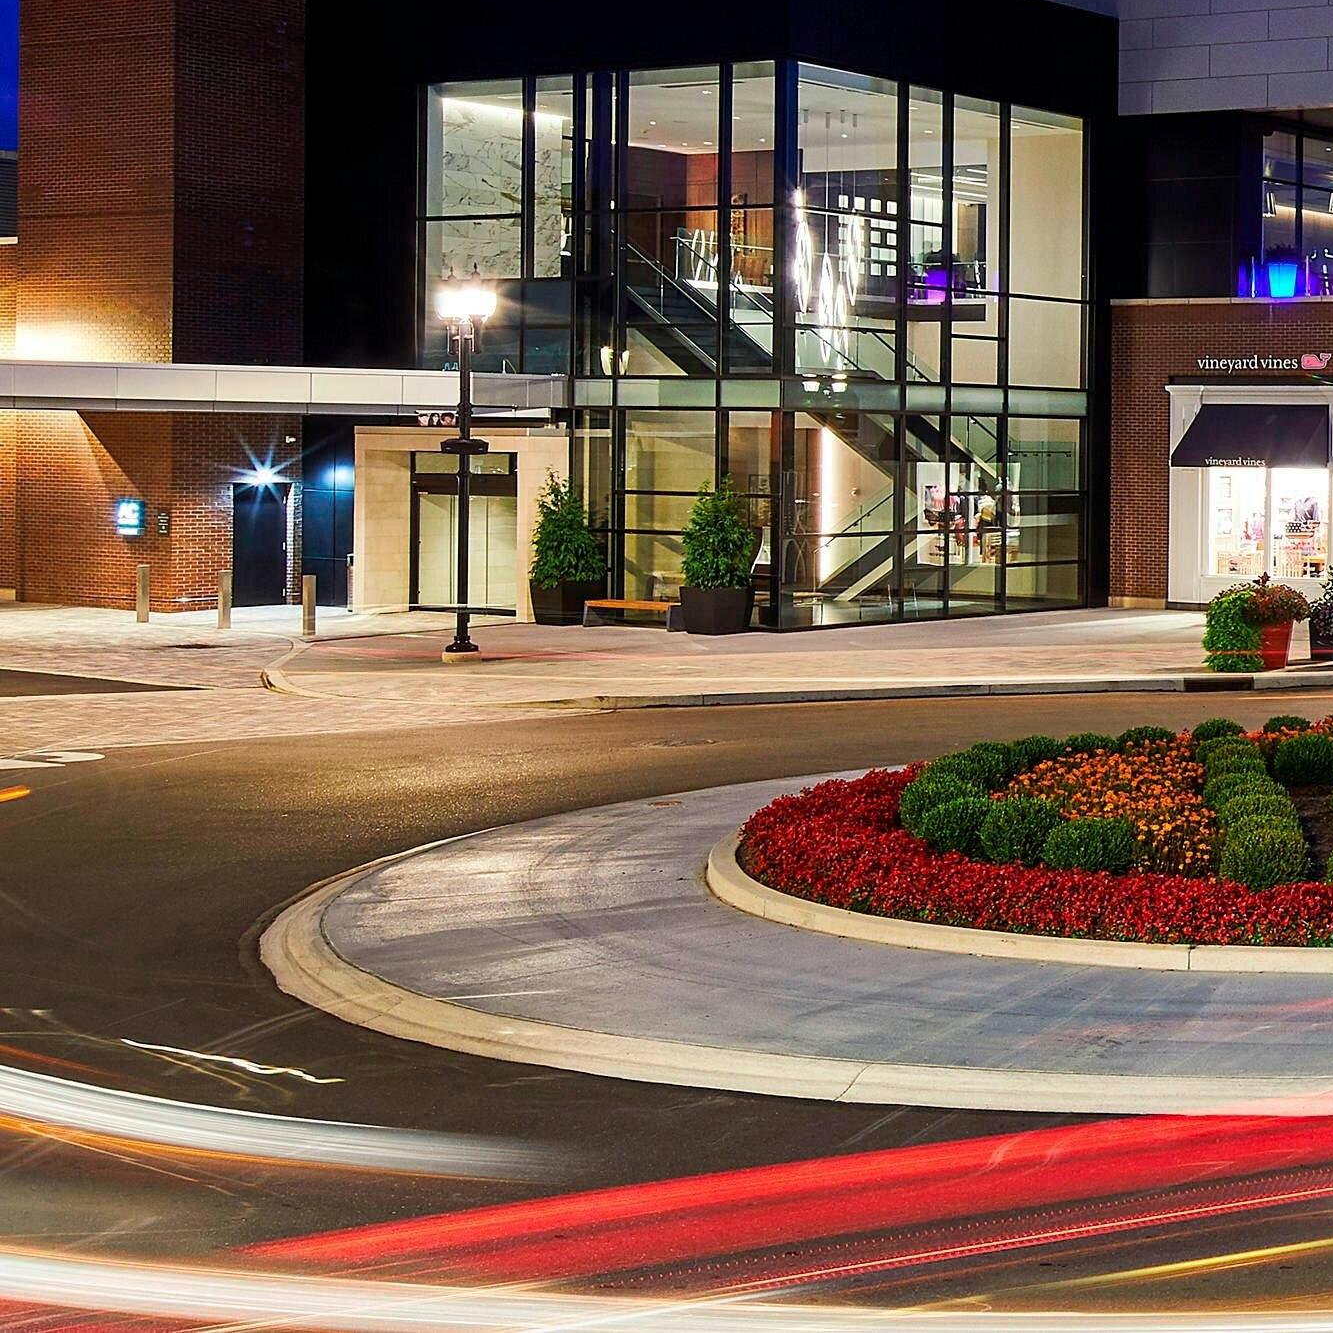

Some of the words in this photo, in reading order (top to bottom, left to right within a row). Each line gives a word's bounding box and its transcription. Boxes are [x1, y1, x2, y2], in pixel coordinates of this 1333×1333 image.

[1197, 355, 1258, 373] vineyard
[1260, 355, 1298, 369] vines
[1204, 456, 1242, 466] vineyard
[1242, 457, 1266, 466] vines
